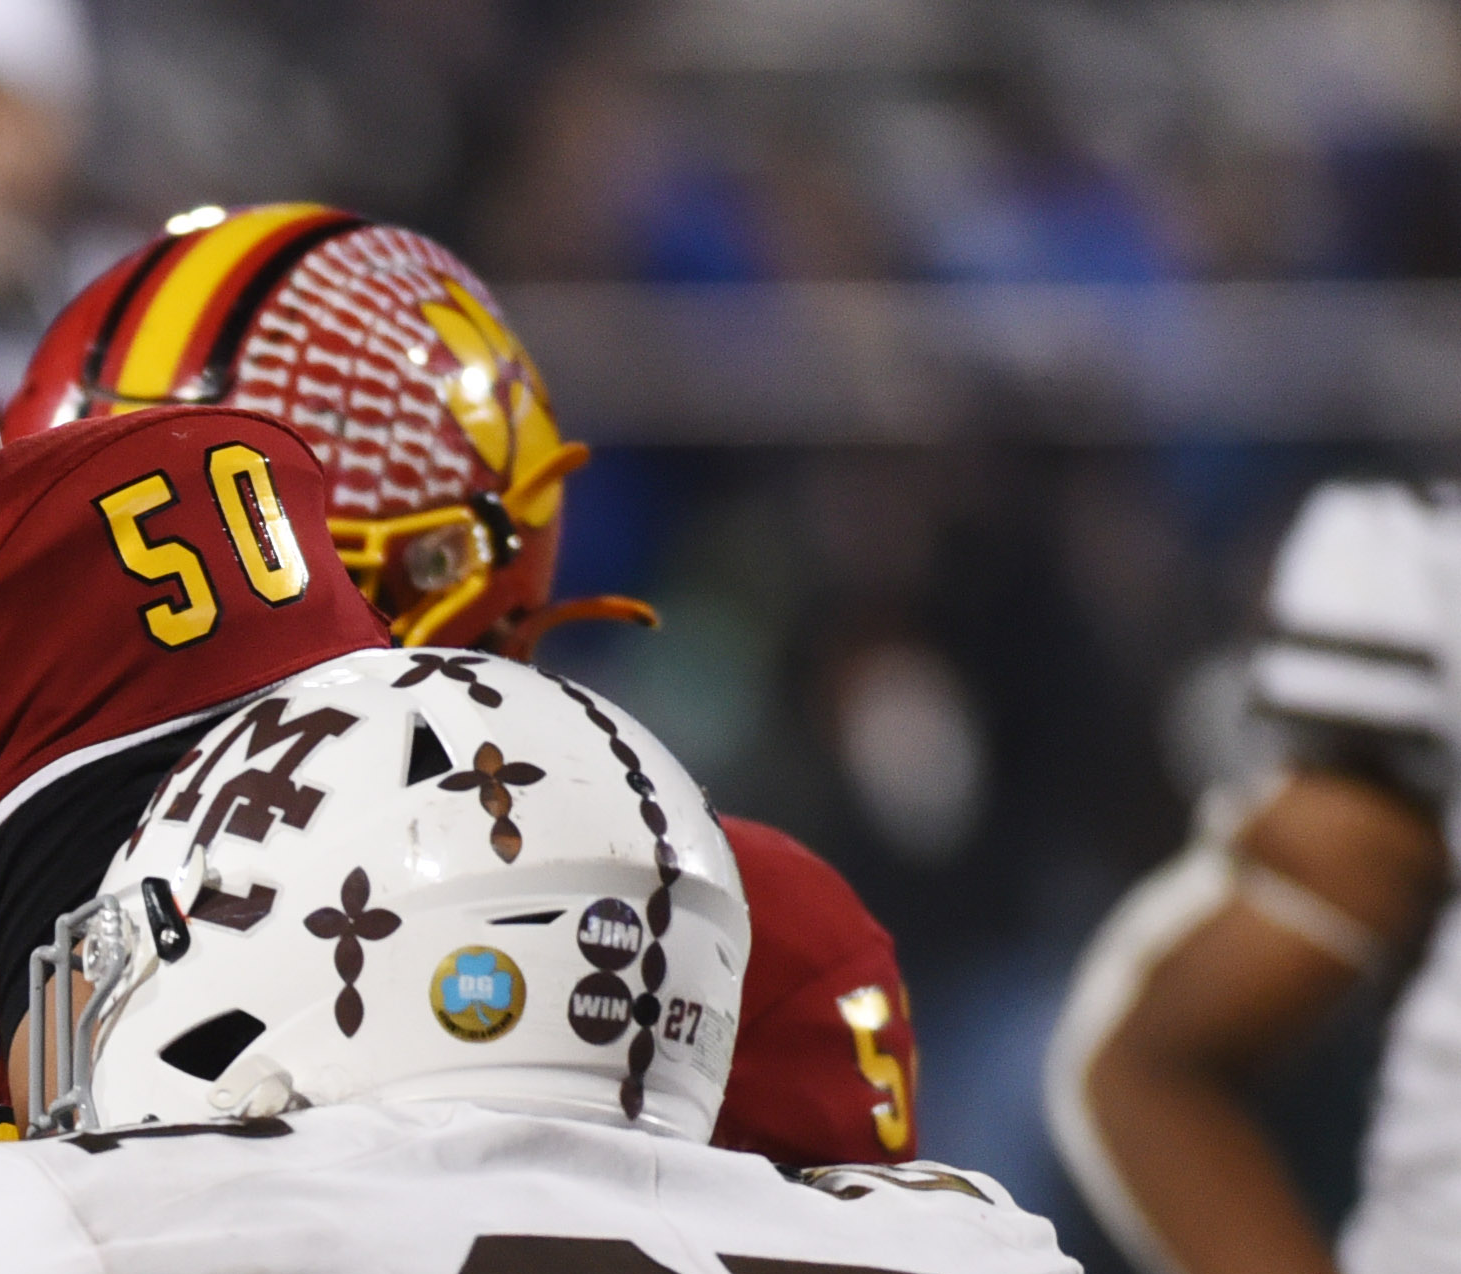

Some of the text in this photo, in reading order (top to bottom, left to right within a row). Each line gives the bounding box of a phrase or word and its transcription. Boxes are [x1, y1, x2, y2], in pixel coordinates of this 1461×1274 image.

[92, 440, 310, 653] 50
[579, 914, 641, 953] JIM
[572, 993, 629, 1022] WIN
[663, 997, 704, 1046] 27
